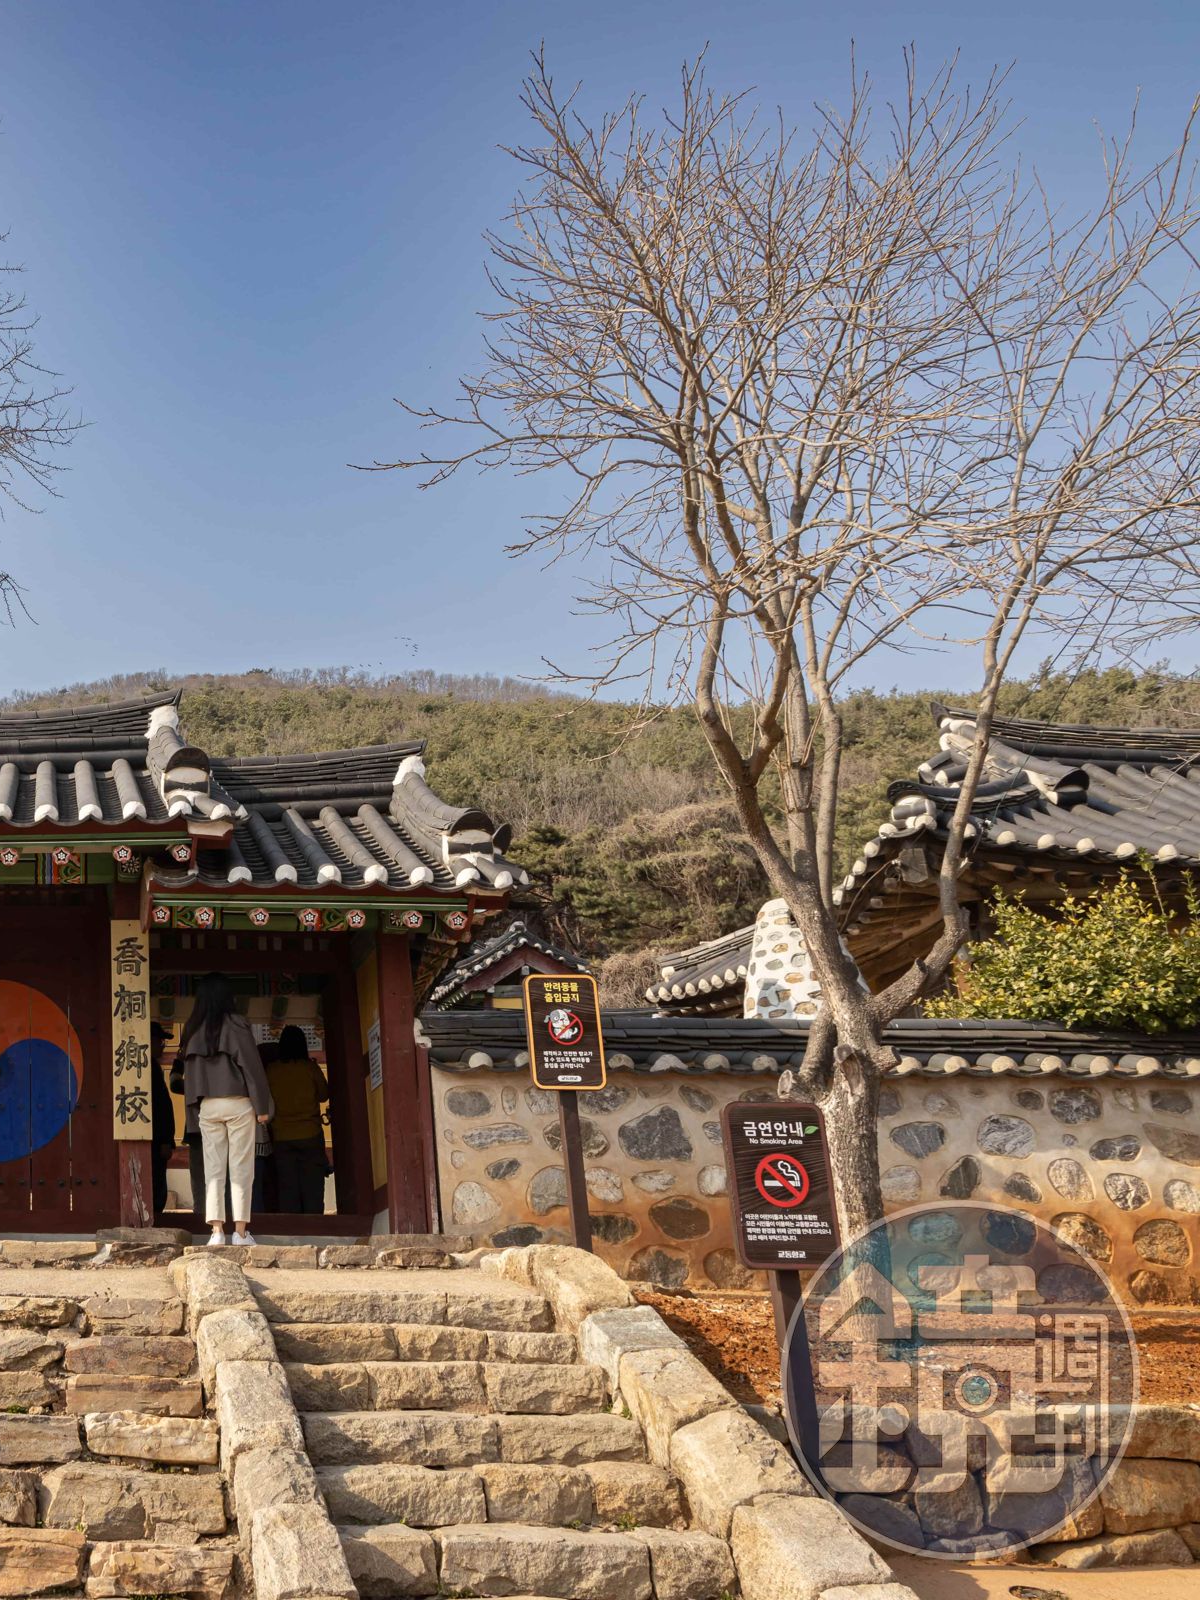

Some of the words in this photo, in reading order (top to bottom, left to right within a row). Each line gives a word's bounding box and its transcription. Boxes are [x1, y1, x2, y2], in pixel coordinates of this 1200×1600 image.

[543, 982, 578, 992] 반려동물
[544, 993, 580, 1003] 출입금지
[742, 1121, 804, 1137] 금연안내
[760, 1138, 787, 1146] Smoking
[778, 1250, 806, 1258] 교동향교
